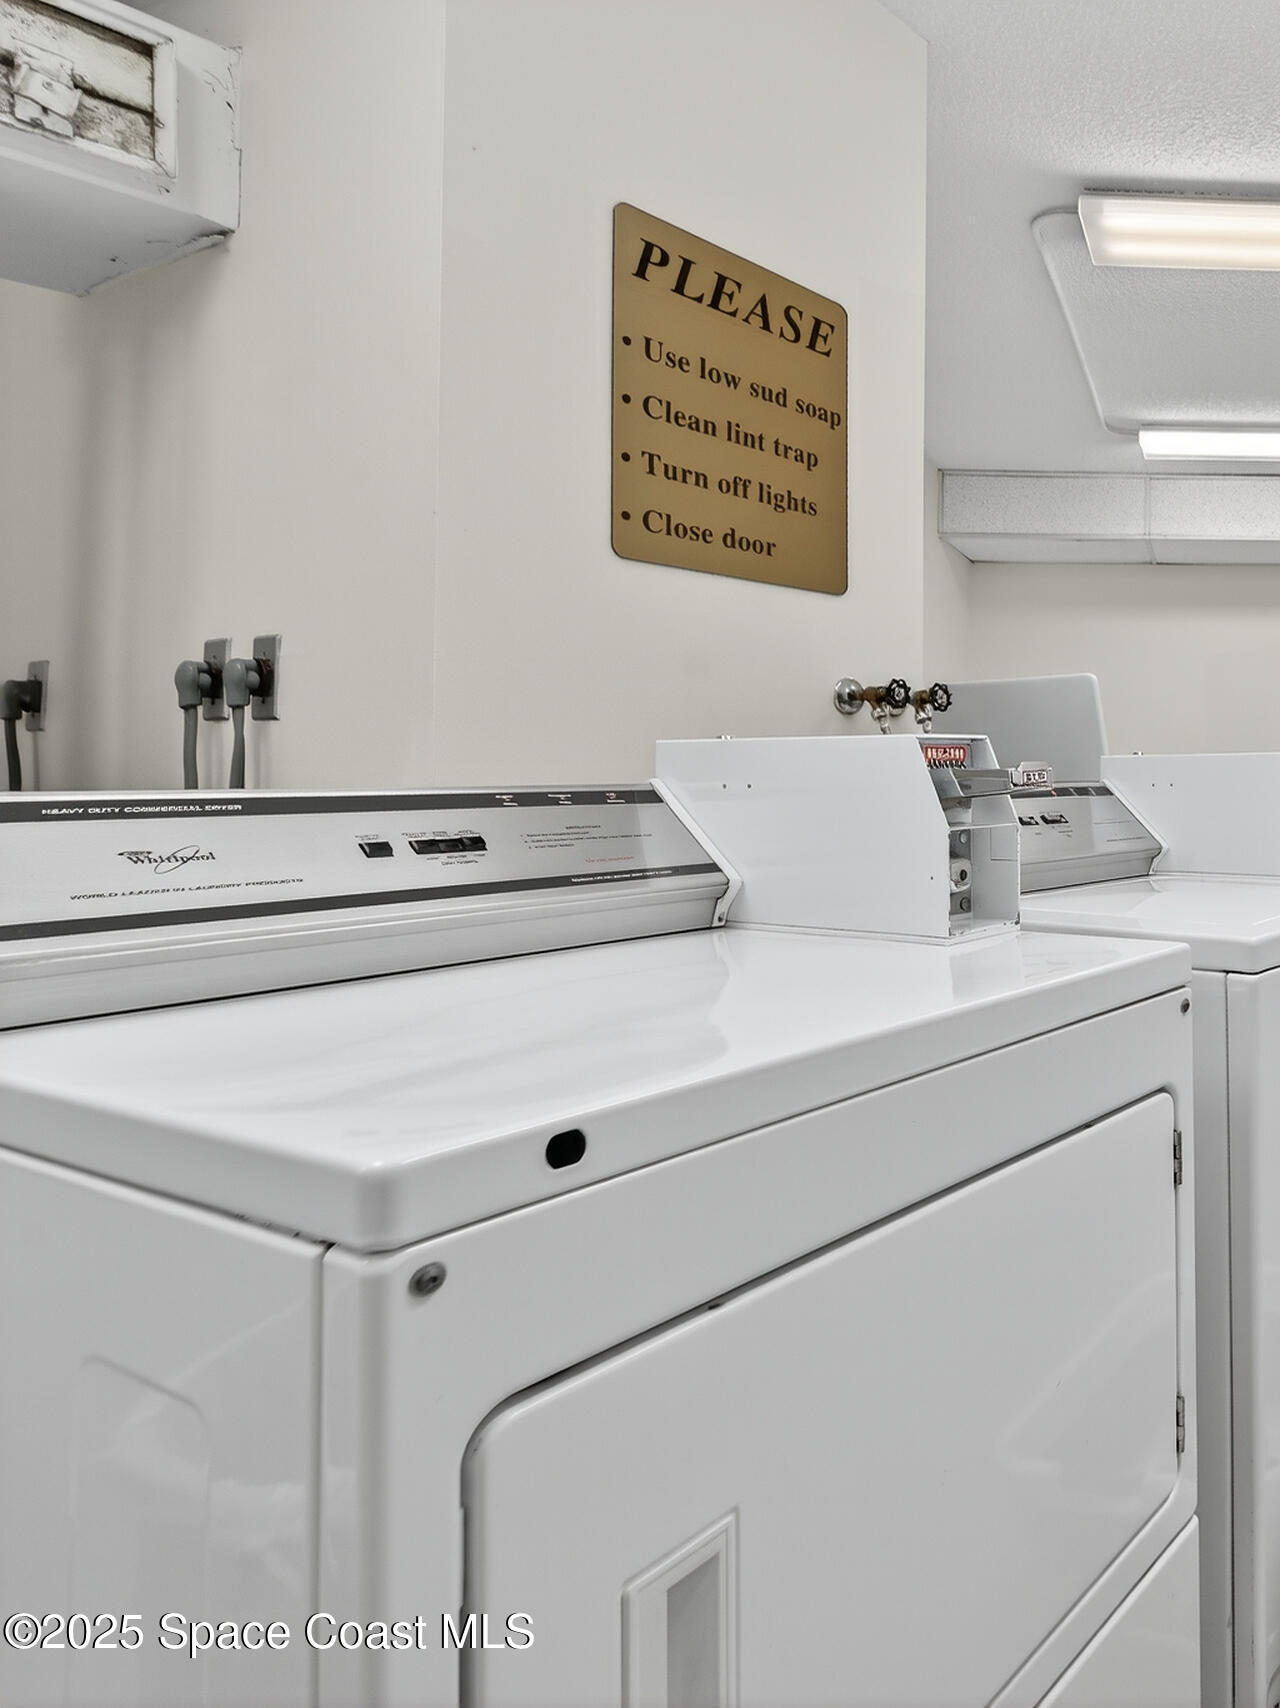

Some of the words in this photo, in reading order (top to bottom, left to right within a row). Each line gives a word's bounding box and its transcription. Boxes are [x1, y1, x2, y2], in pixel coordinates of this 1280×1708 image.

[631, 237, 837, 358] PLEASE
[643, 335, 691, 374] Use
[700, 357, 741, 391] low
[749, 381, 788, 408] sud
[795, 398, 842, 430] soap
[642, 394, 718, 438] Clean
[726, 421, 766, 453] lint
[773, 439, 819, 473] trap
[641, 451, 709, 490] Turn
[718, 473, 752, 500] off
[758, 482, 818, 518] lights
[642, 509, 714, 545] Close
[722, 527, 777, 558] door
